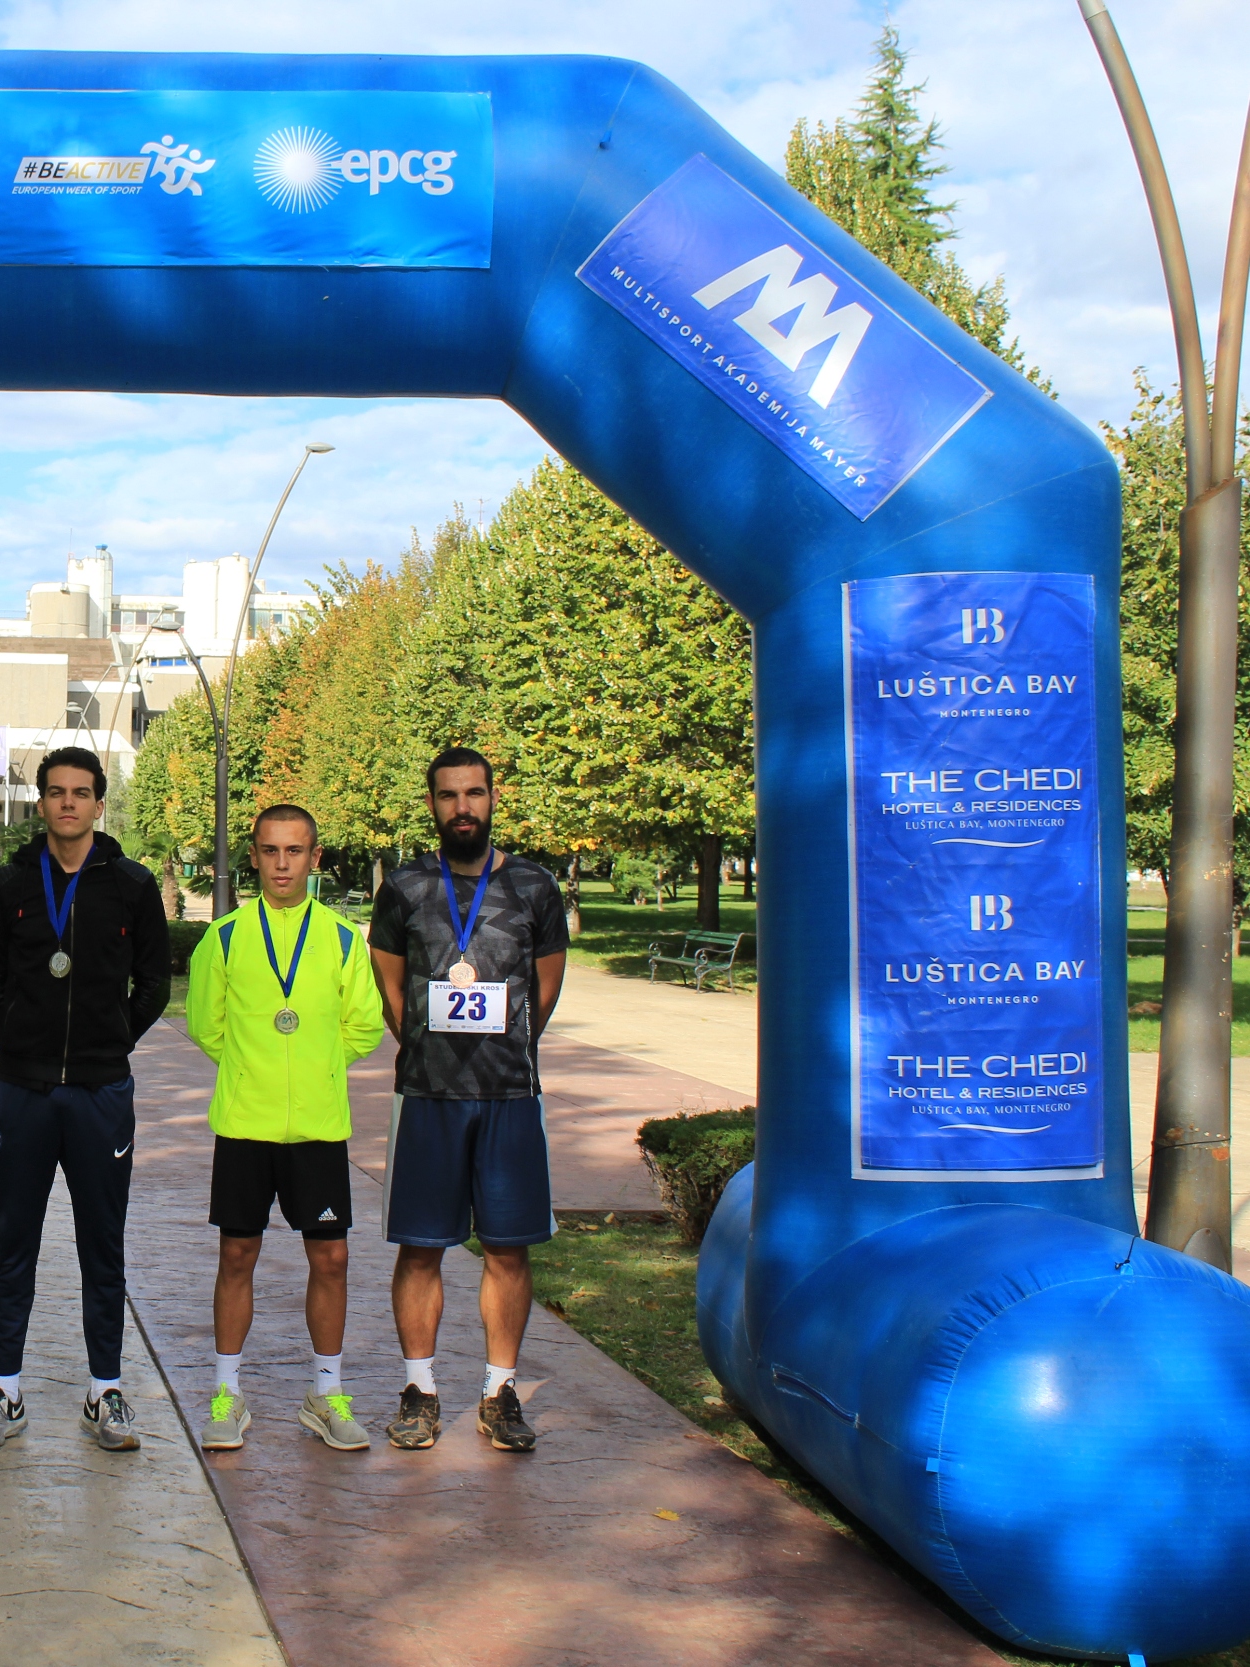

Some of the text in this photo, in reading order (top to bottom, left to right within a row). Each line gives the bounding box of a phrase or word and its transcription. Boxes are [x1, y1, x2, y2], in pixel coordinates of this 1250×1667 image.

[23, 162, 144, 179] #BEACTIVE
[340, 148, 458, 196] epcg
[12, 186, 142, 195] EUROPEAN WEEK OF SPORT
[610, 265, 867, 487] MULTISPORT AKADEMIJA MAYER
[878, 671, 1077, 698] LUŠTICA BAY
[940, 709, 1031, 718] MONTENEGRO
[881, 768, 1081, 794] THE CHEDI
[882, 800, 1081, 815] HOTEL & RESIDENCES
[905, 818, 1065, 830] LUŠTICA BAY, MONTENEGRO
[886, 957, 1085, 983] LUŠTICA BAY
[448, 991, 487, 1021] 23
[947, 996, 1039, 1005] MONTENEGRO
[887, 1052, 1086, 1078] THE CHEDI
[889, 1083, 1087, 1099] HOTEL & RESIDENCES
[912, 1103, 1071, 1115] LUŠTICA BAY, MONTENEGRO
